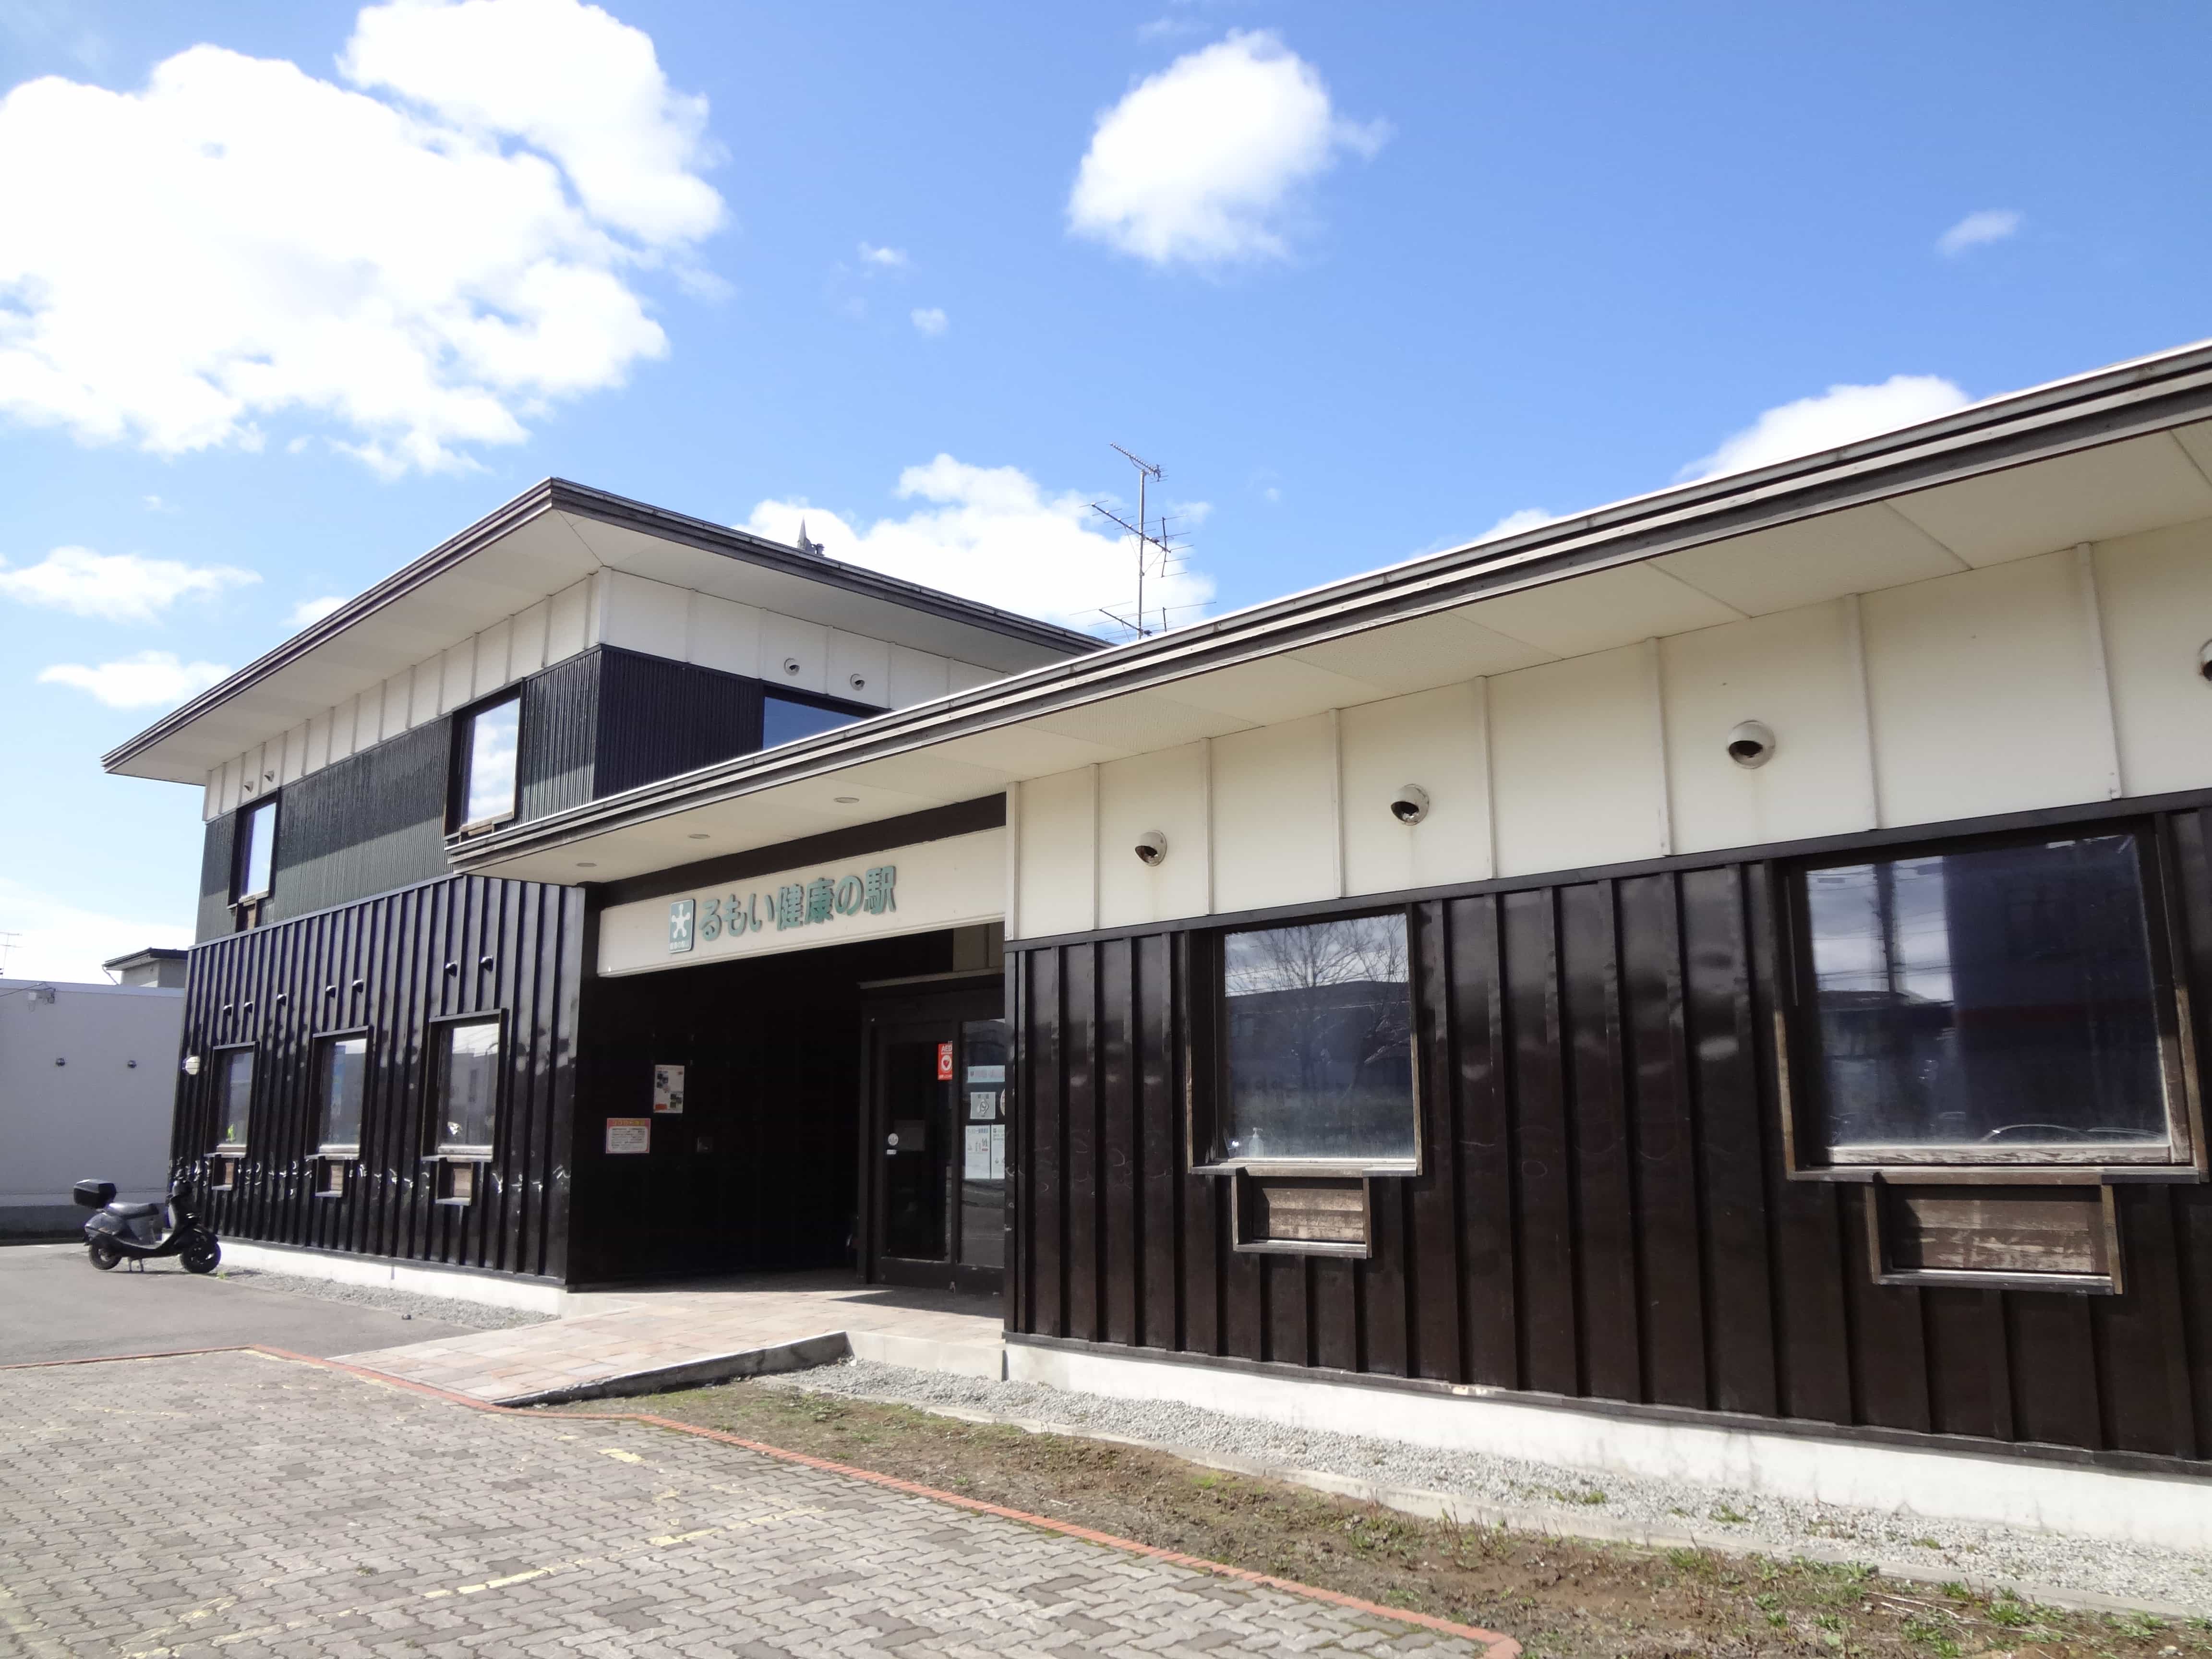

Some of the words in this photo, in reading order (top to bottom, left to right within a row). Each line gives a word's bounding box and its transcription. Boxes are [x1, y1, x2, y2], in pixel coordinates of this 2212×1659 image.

[700, 866, 896, 941] るもい健康の駅
